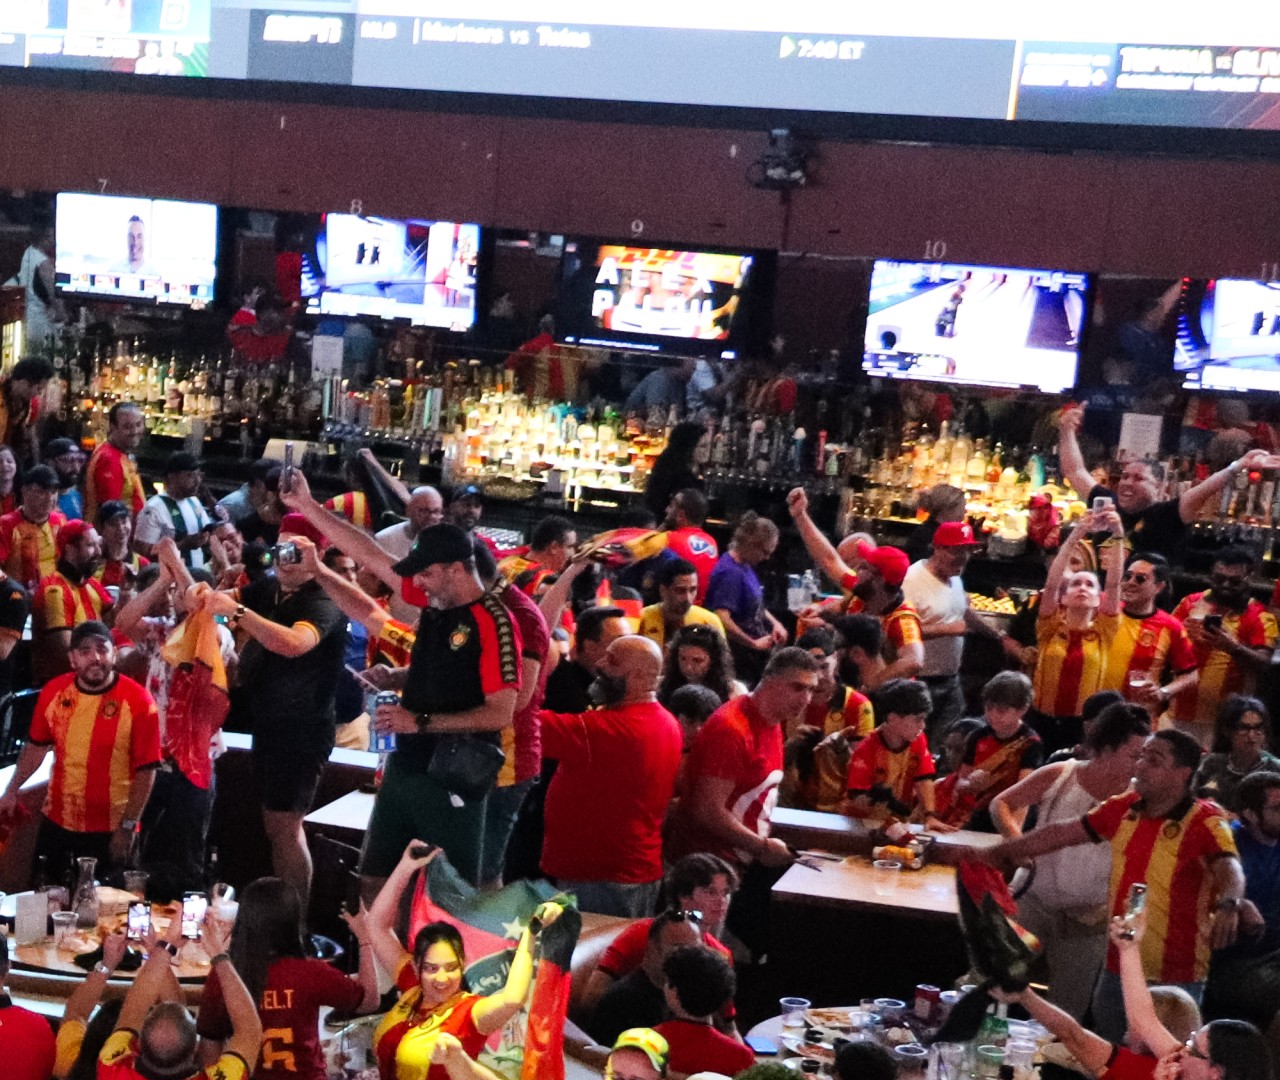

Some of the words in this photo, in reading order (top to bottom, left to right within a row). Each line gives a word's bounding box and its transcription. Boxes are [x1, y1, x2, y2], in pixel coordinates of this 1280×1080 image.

[839, 41, 865, 60] ET
[631, 219, 644, 238] 9
[923, 239, 948, 260] 10
[595, 257, 713, 293] ALEX
